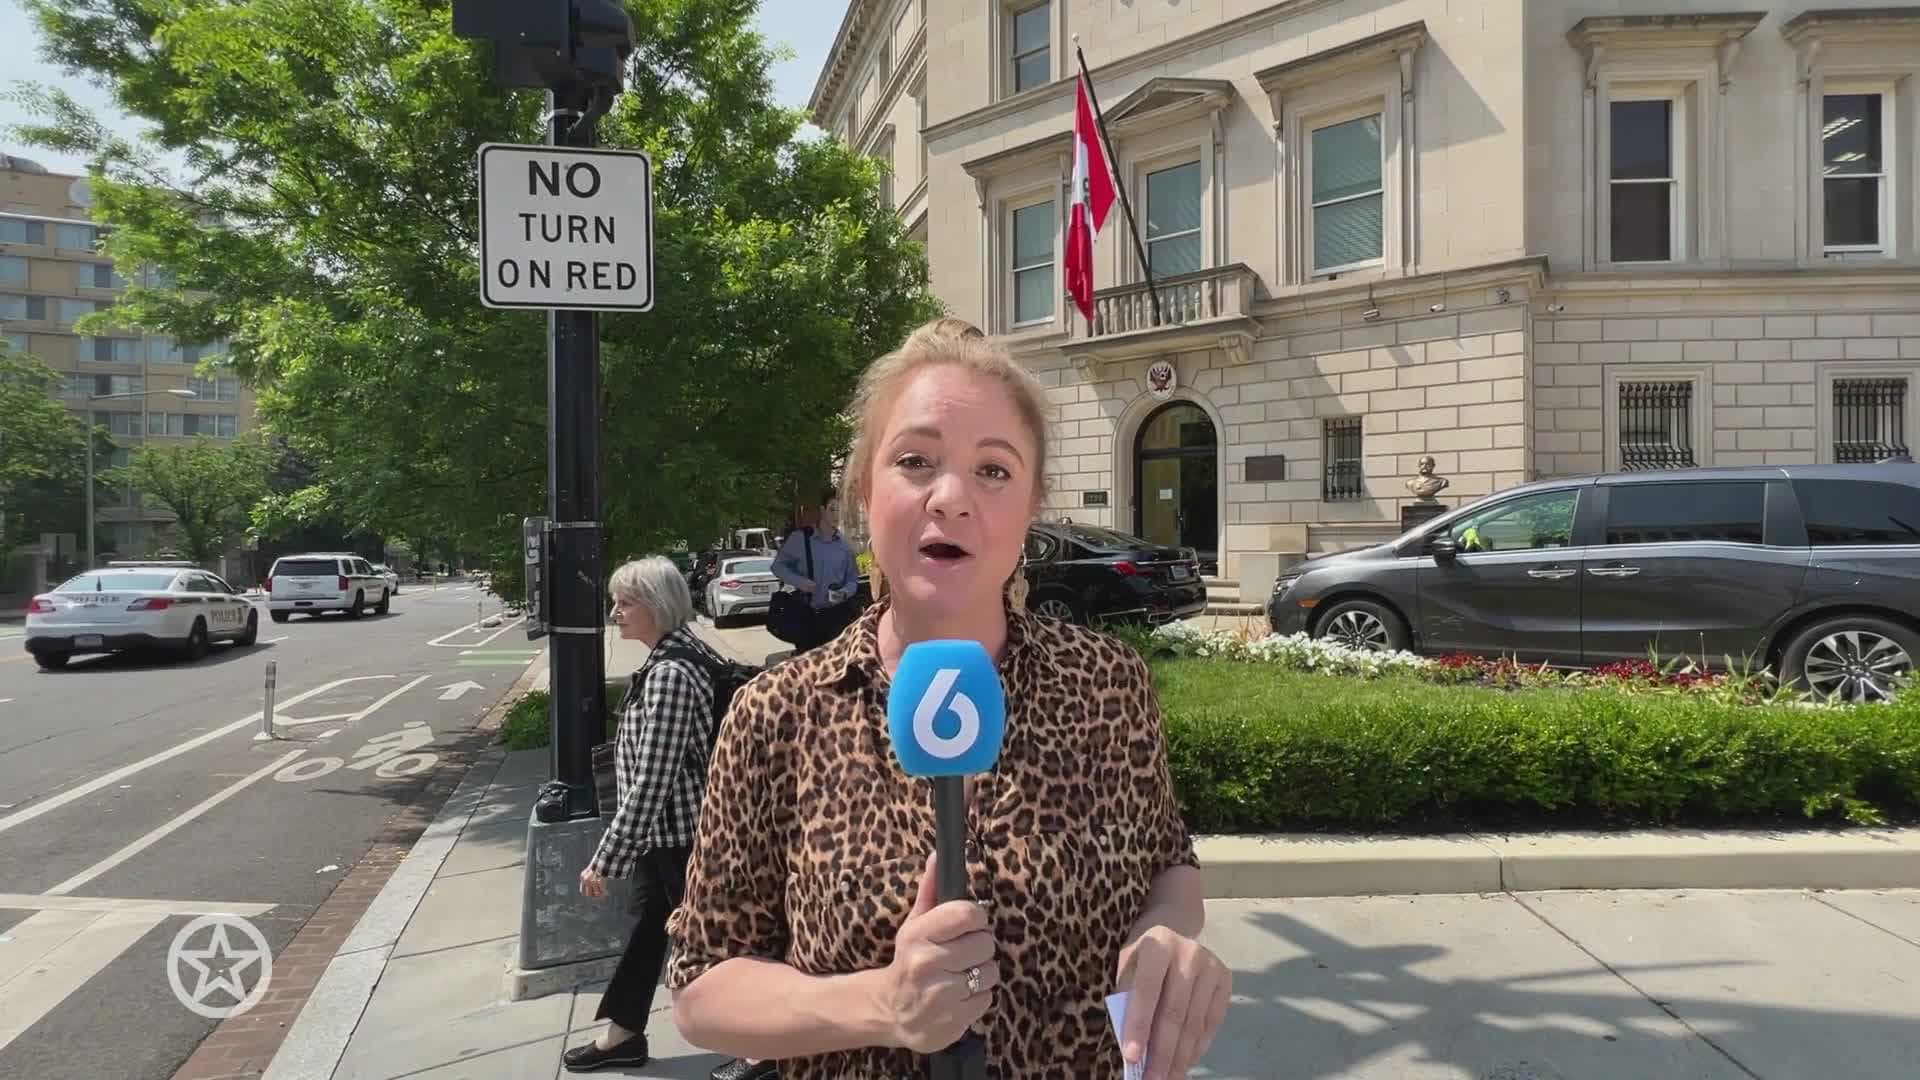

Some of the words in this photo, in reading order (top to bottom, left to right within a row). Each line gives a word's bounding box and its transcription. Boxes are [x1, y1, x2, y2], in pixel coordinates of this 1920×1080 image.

[528, 160, 601, 199] NO
[518, 213, 616, 244] TURN
[498, 259, 551, 288] ON
[567, 261, 637, 290] RED
[912, 668, 981, 760] 6
